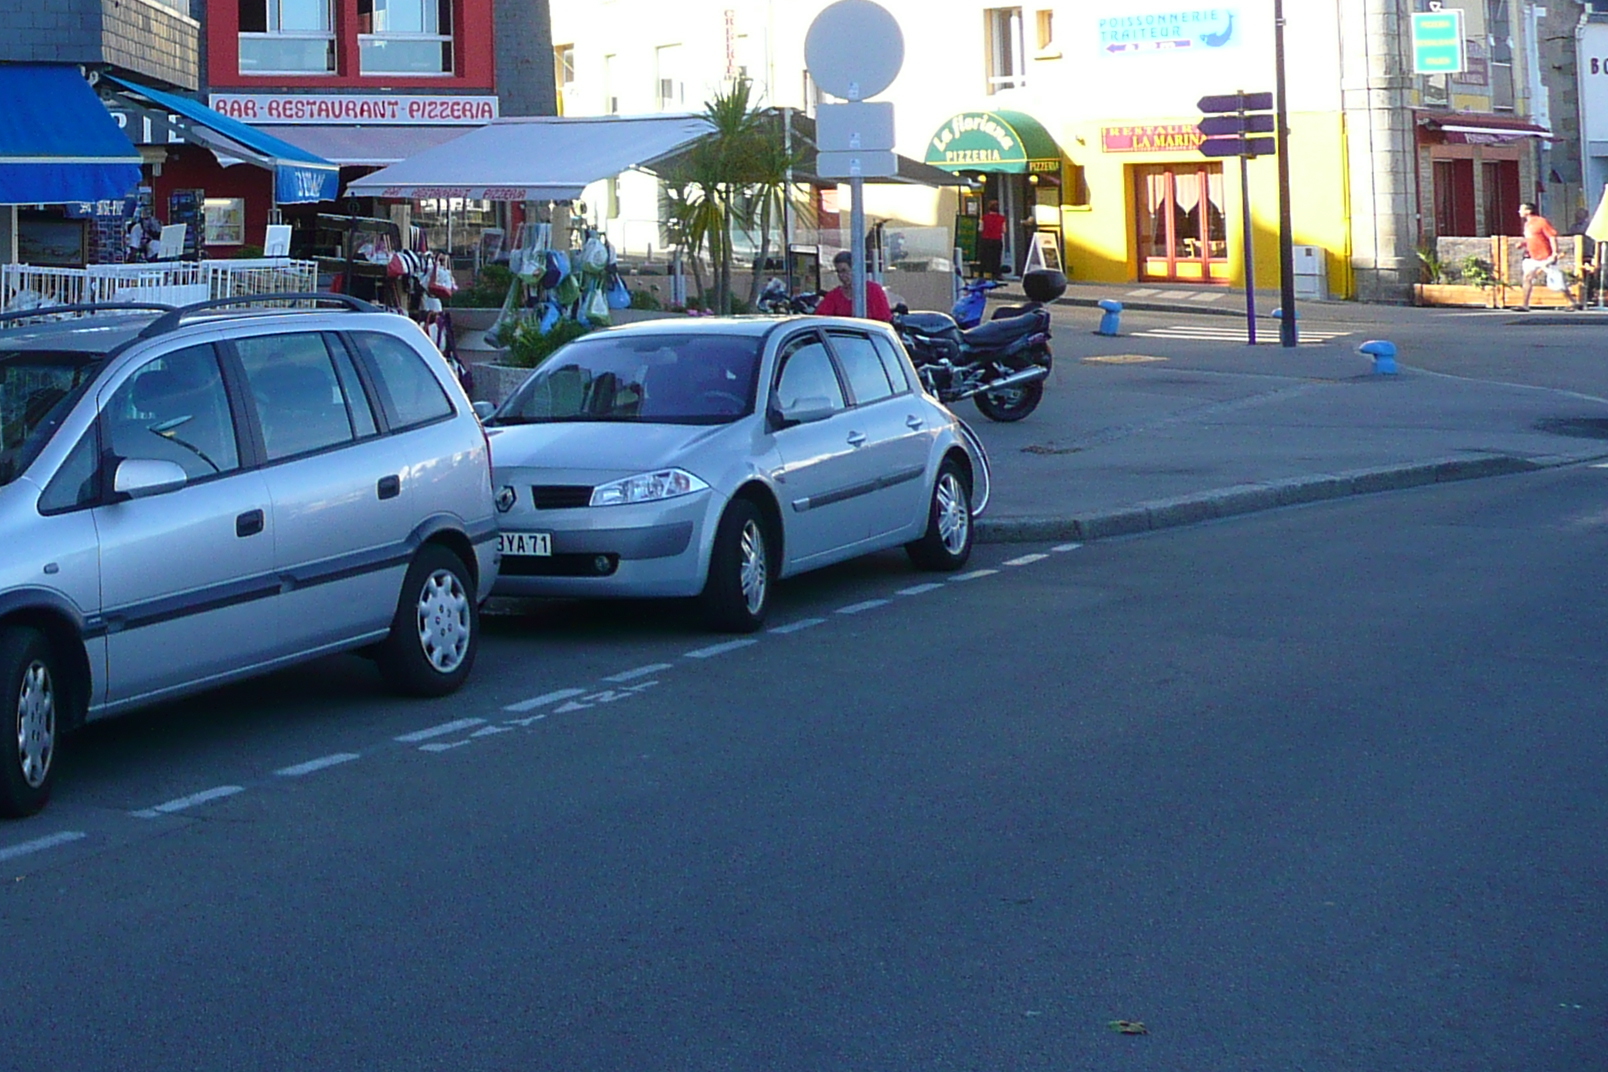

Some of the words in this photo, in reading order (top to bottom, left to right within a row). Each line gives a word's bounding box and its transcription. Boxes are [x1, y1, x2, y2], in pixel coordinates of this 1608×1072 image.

[1099, 9, 1218, 28] POISSONNERIE
[1100, 25, 1182, 41] TRAITEUR
[215, 99, 258, 119] BAR
[267, 100, 398, 120] RESTAURANT
[408, 101, 493, 120] PIZZERIA
[945, 149, 1001, 162] PIZZERIA
[1029, 161, 1059, 172] PIZZERIA
